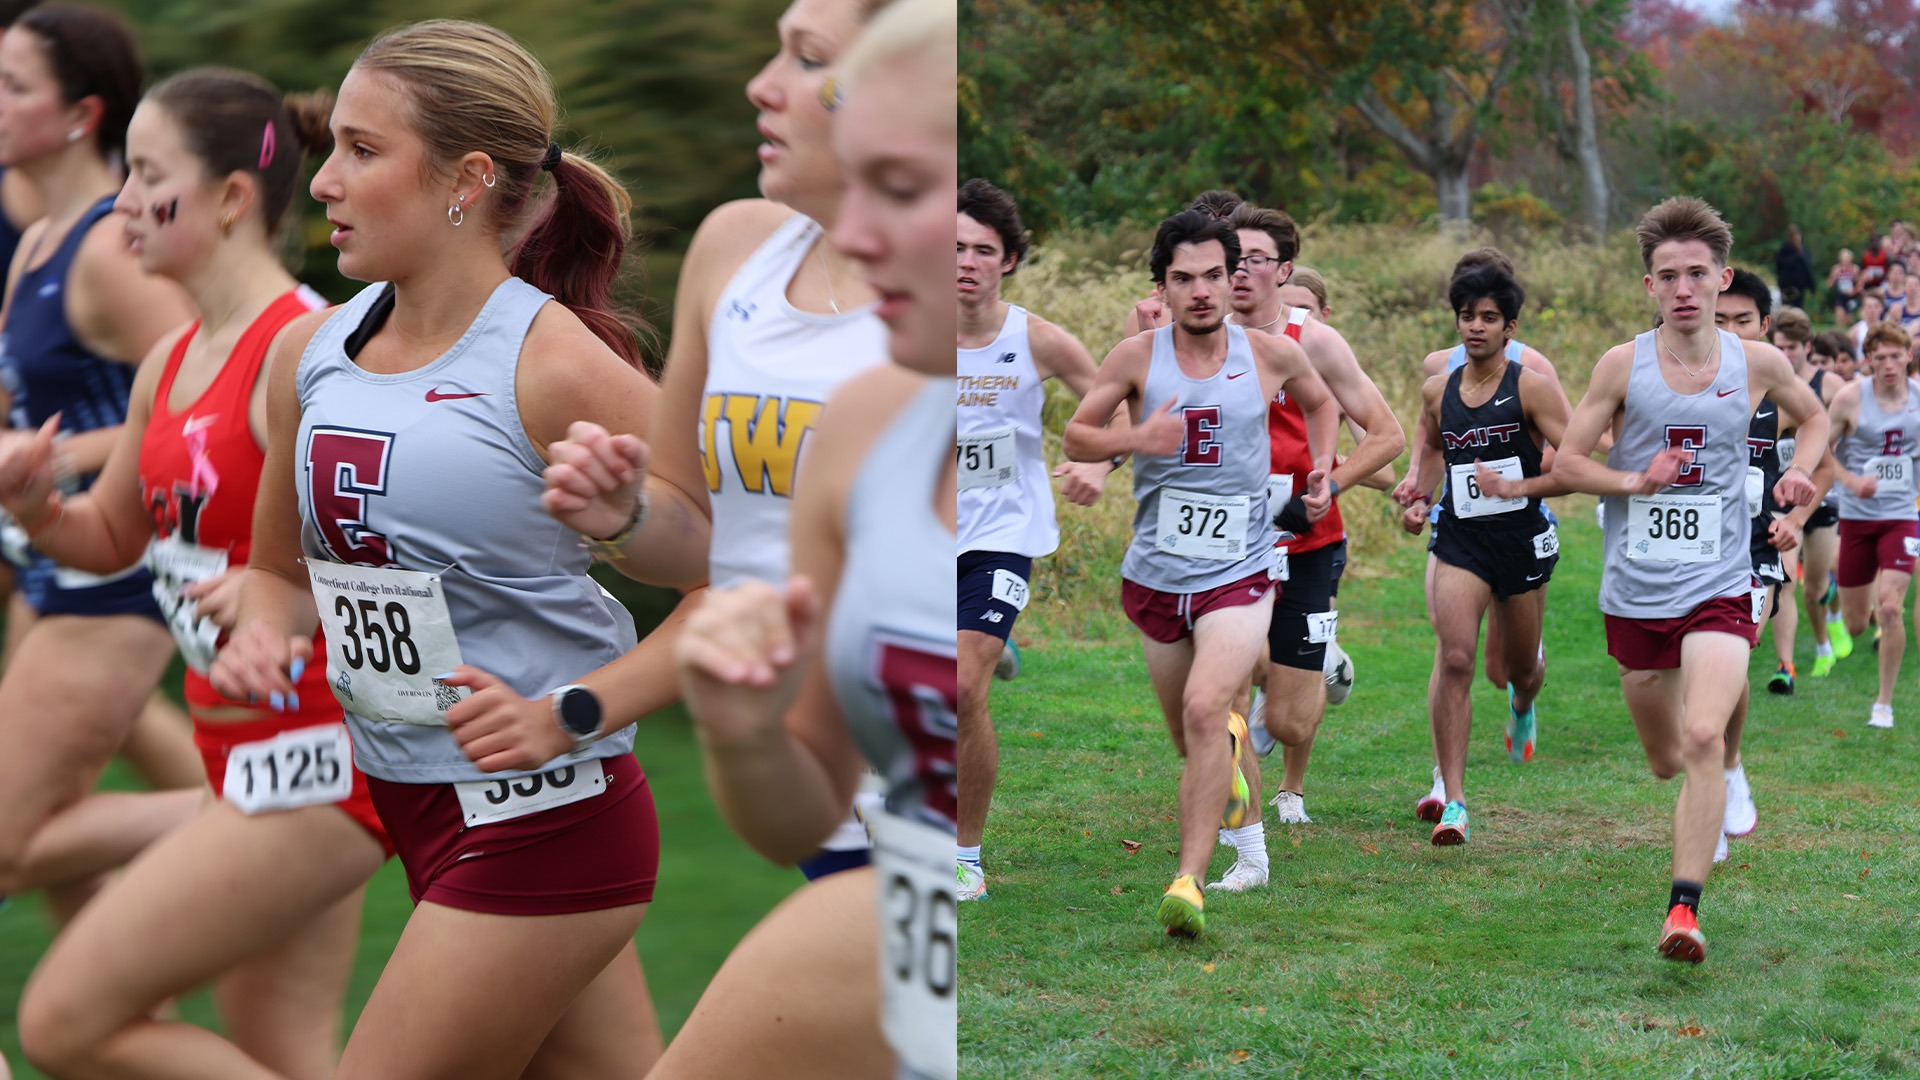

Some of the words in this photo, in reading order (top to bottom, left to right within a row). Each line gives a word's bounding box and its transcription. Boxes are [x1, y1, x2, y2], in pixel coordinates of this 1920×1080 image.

[1181, 404, 1224, 468] E
[1442, 422, 1520, 450] MIT
[1882, 429, 1904, 456] E
[1664, 425, 1707, 488] E
[1876, 463, 1903, 481] 369
[305, 424, 397, 570] E
[1178, 504, 1229, 540] 372
[1648, 507, 1700, 541] 368
[313, 571, 350, 591] Connecticut
[350, 580, 381, 597] College
[381, 584, 434, 598] Invitational
[334, 595, 421, 676] 358
[242, 741, 341, 799] 1125
